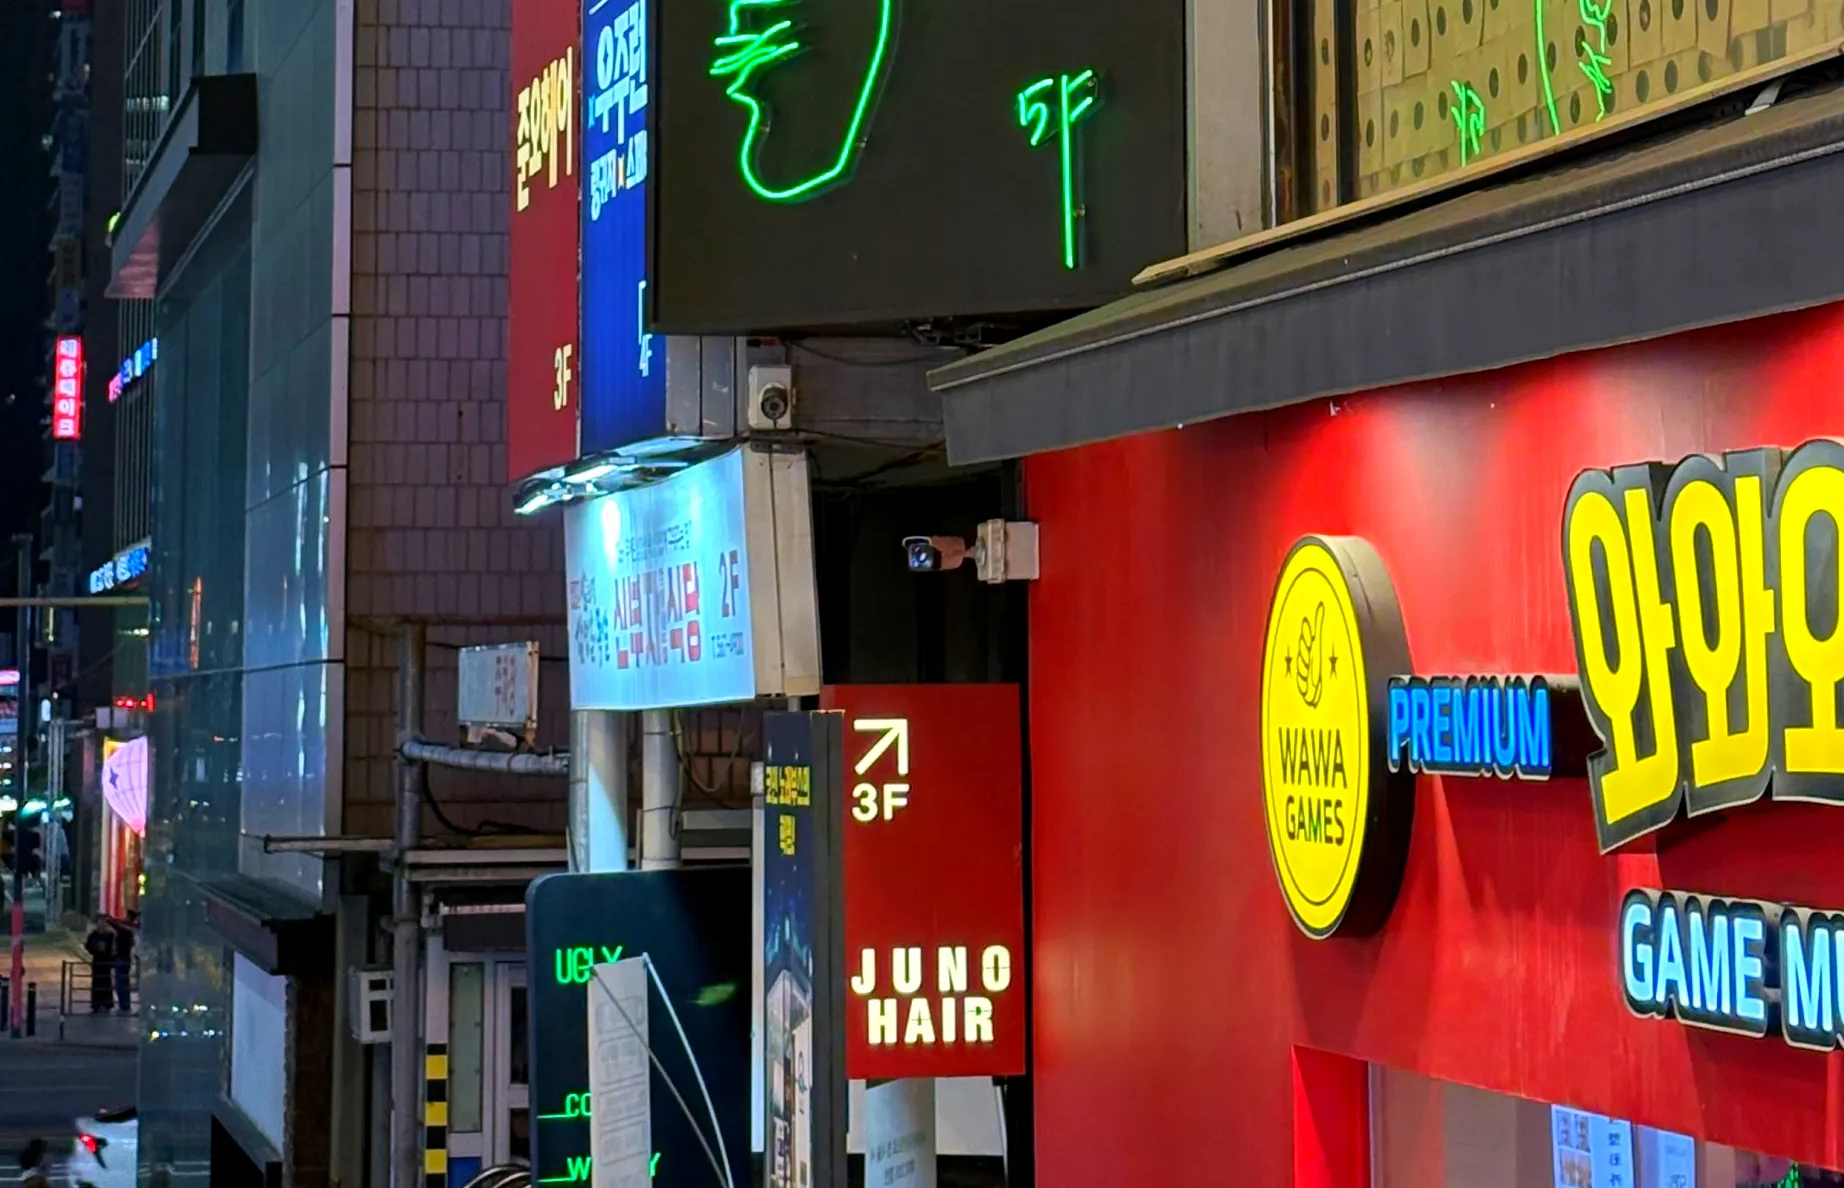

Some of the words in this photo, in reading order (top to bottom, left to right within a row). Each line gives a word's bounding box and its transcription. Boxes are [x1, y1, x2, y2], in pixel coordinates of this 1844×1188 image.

[516, 46, 573, 212] 준오헤어
[1016, 68, 1095, 269] 5F
[553, 343, 573, 411] 3F
[639, 333, 653, 378] 4F
[718, 548, 740, 619] 2F
[1278, 726, 1348, 789] WAWA
[1391, 688, 1550, 767] PREMIUM
[851, 782, 909, 822] 3F
[1284, 795, 1346, 846] GAMES
[851, 944, 1011, 995] JUNO
[1623, 903, 1766, 1020] GAME
[867, 996, 994, 1045] HAIR
